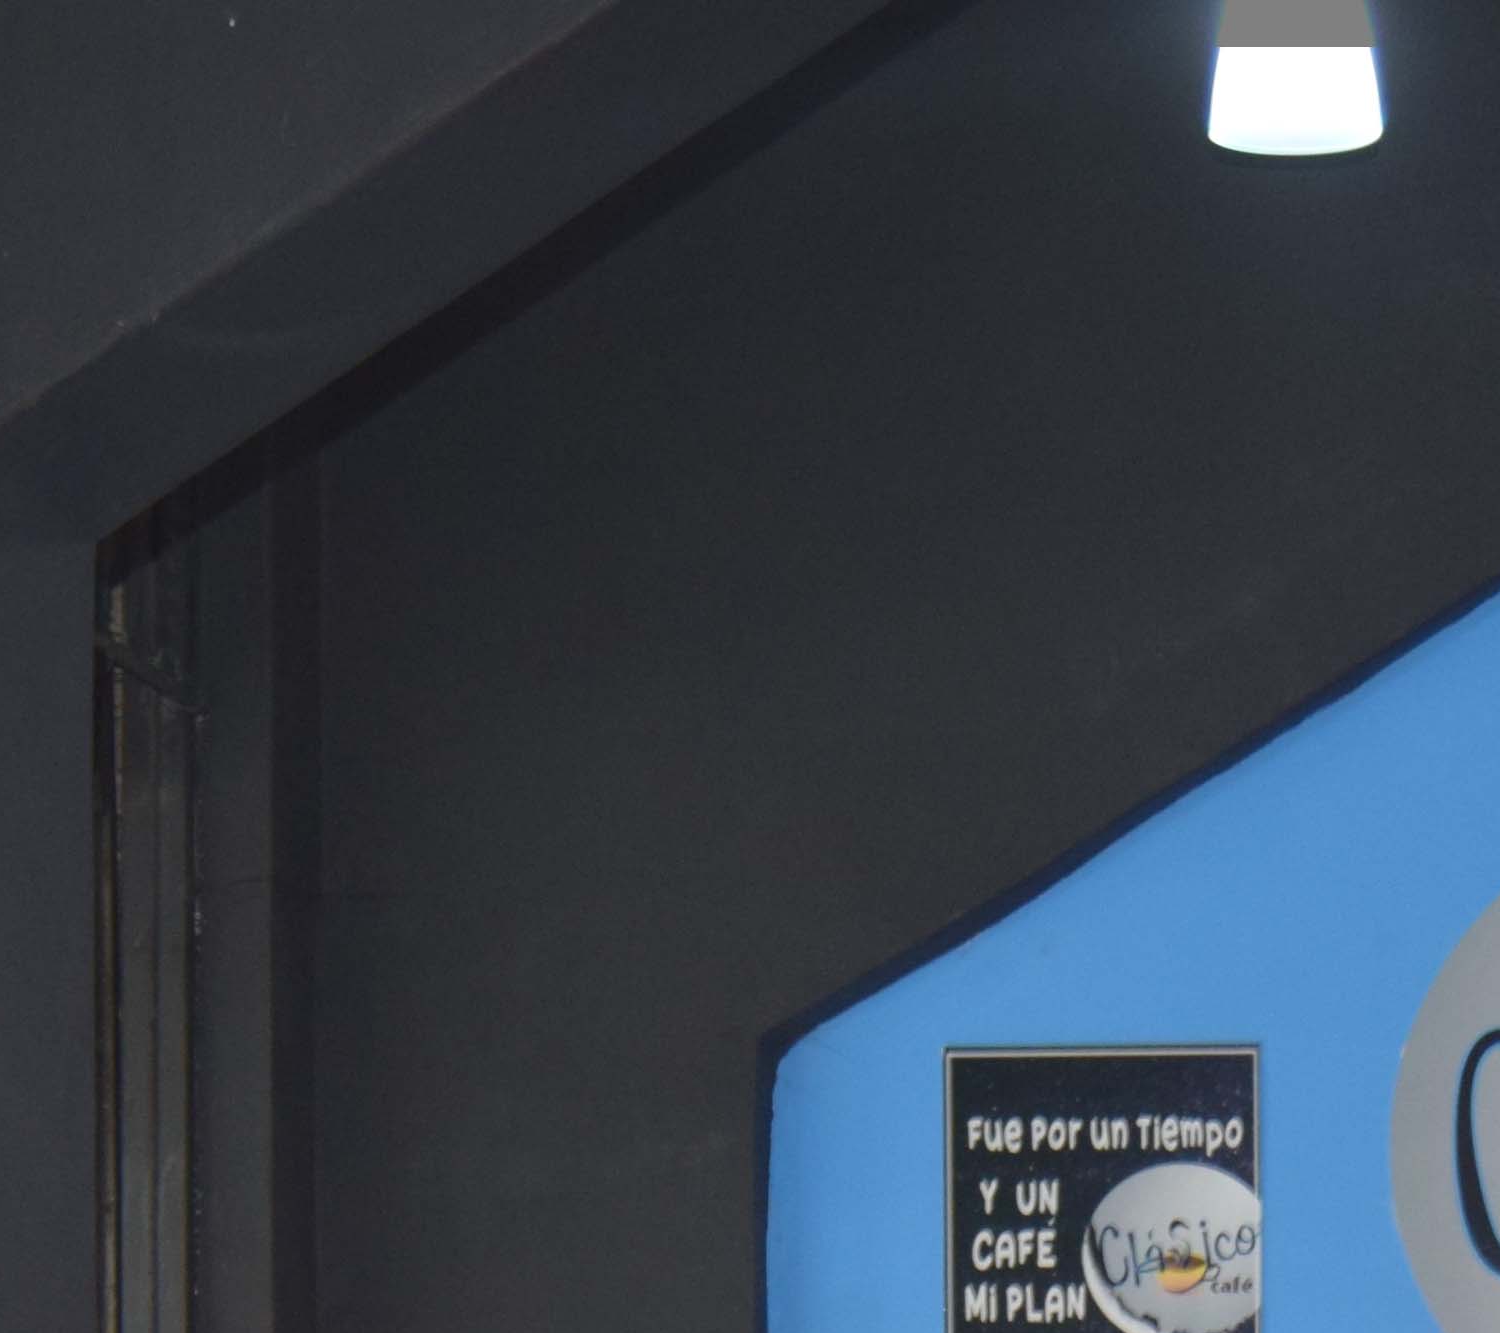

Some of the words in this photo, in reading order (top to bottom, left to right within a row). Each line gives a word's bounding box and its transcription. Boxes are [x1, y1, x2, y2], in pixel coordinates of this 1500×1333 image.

[979, 1178, 999, 1215] Y
[1015, 1178, 1060, 1215] UN
[971, 1217, 1057, 1271] CAFÉ
[1006, 1281, 1088, 1324] PLAN
